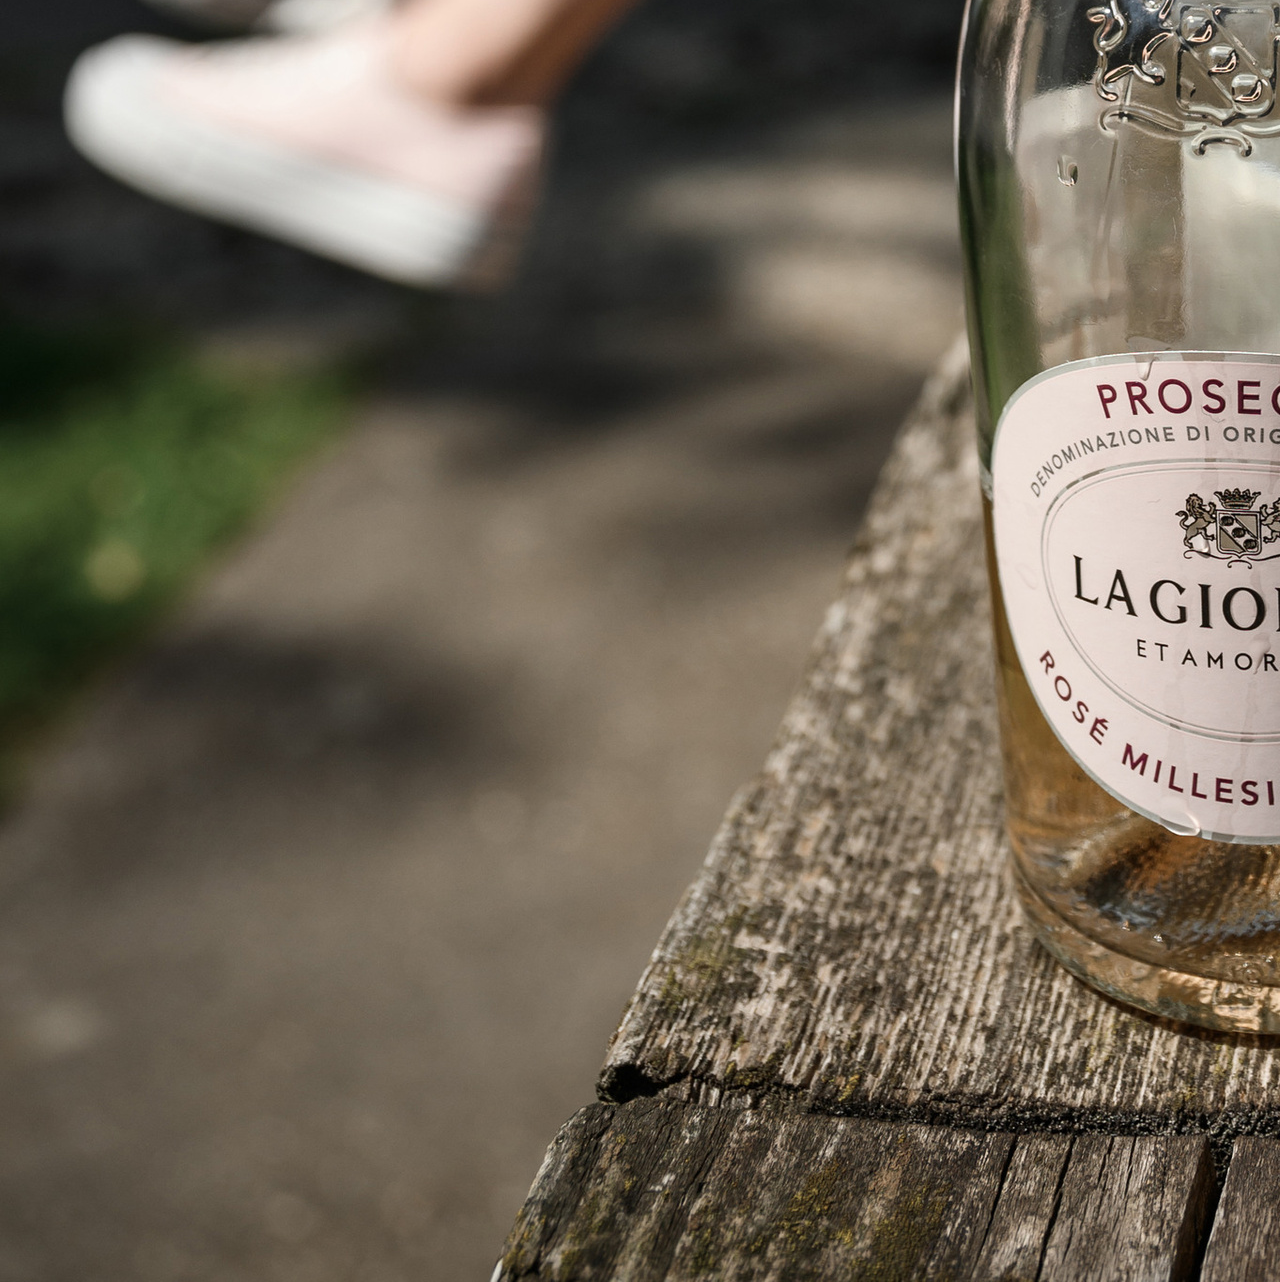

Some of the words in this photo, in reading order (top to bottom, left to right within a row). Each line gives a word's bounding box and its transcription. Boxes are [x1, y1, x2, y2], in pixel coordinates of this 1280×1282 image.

[1030, 426, 1176, 498] DENOMINAZIONE
[1186, 425, 1210, 442] DI
[1039, 650, 1109, 746] ROSÉ
